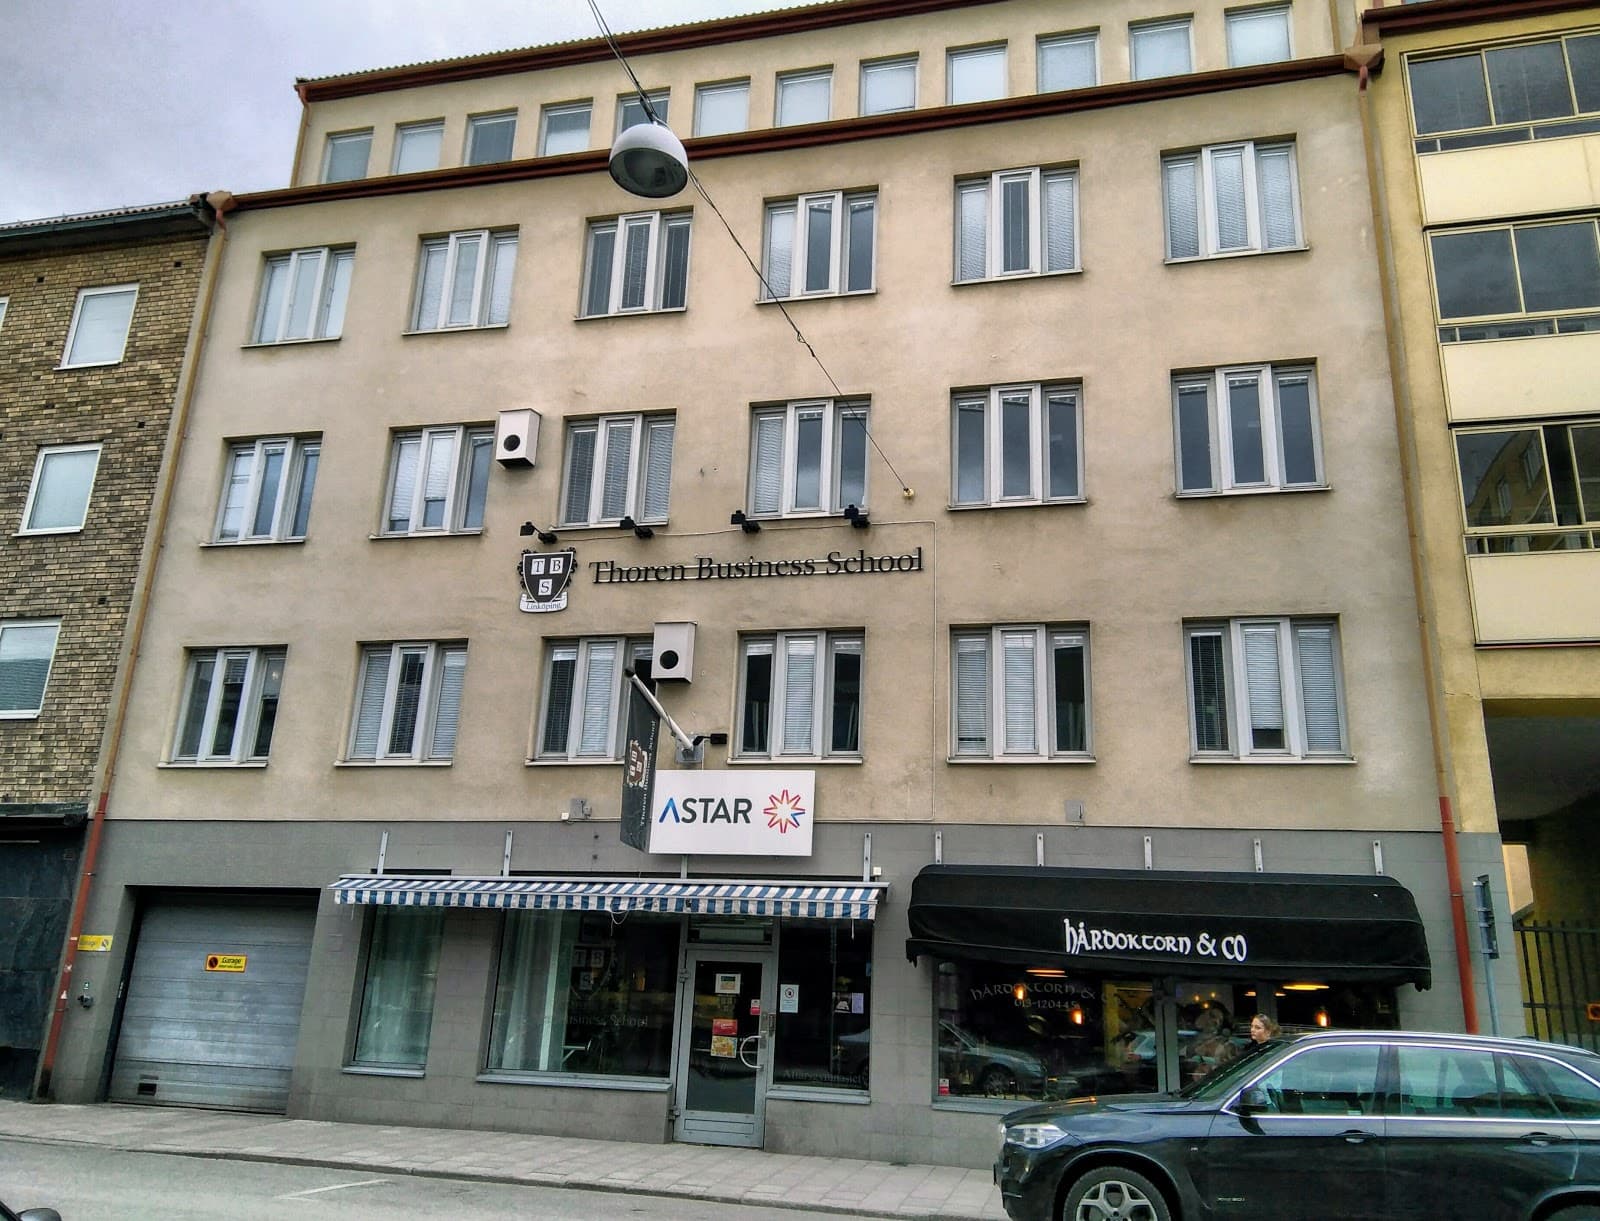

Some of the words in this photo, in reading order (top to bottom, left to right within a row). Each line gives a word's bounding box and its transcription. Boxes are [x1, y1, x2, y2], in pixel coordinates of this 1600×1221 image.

[589, 559, 686, 584] Thoren
[696, 555, 815, 580] Business
[826, 546, 923, 575] School
[659, 797, 753, 824] ASTAR
[222, 956, 242, 966] Garage
[1196, 932, 1217, 956] &
[1221, 934, 1247, 962] CO
